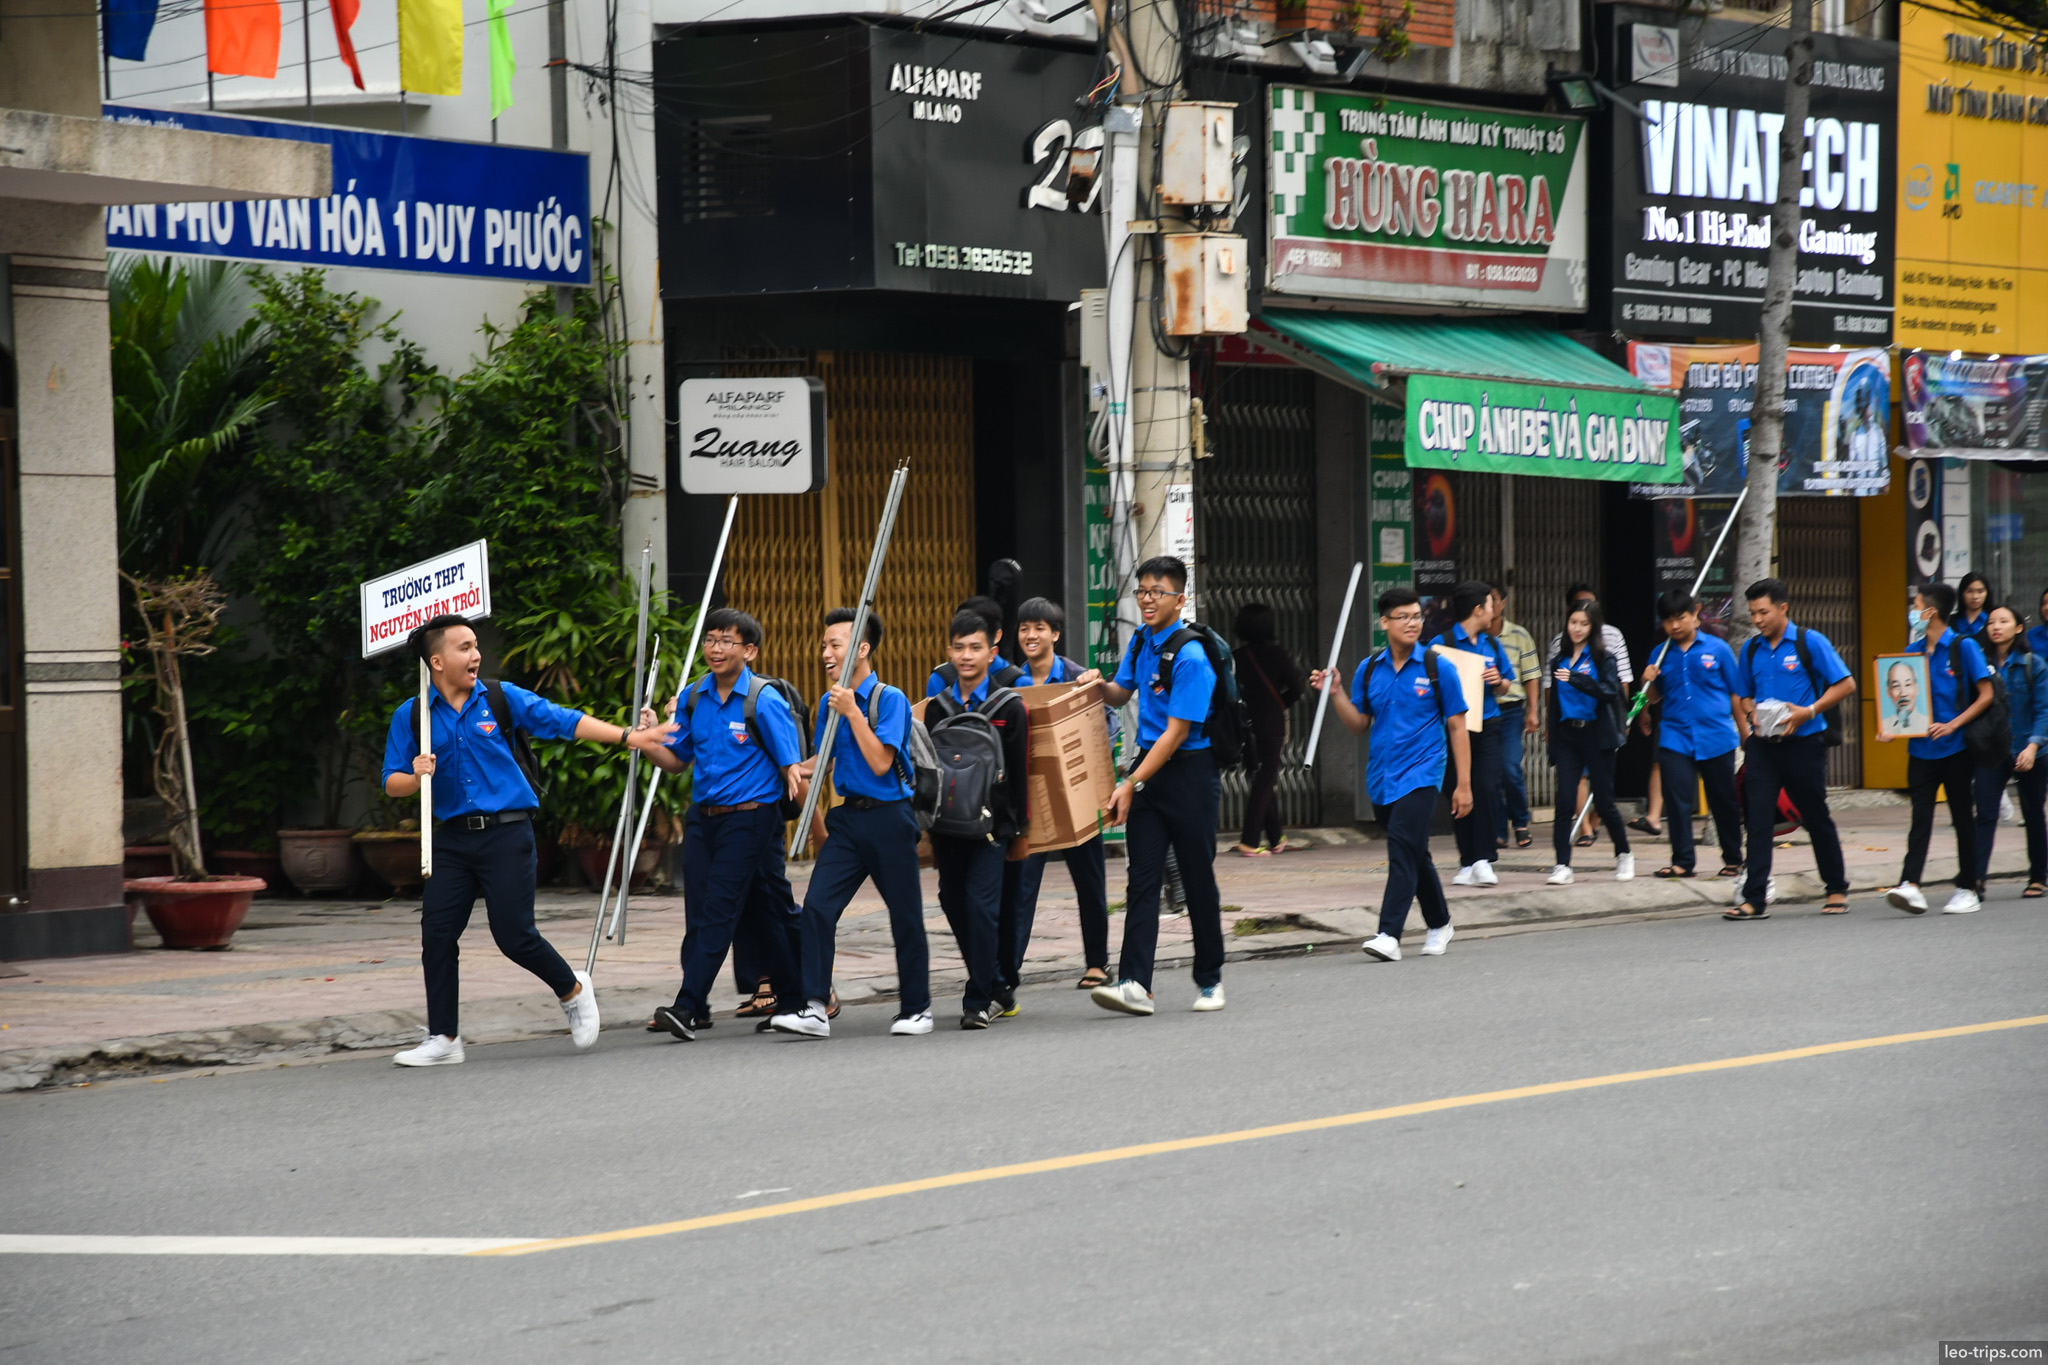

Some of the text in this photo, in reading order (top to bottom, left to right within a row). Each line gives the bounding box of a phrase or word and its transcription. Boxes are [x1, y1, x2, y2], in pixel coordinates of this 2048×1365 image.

[890, 62, 982, 100] ALFAPARF
[1339, 108, 1388, 135] TRUNG
[319, 179, 386, 256] HÓA
[392, 200, 408, 259] 1
[415, 201, 476, 264] DUY
[484, 196, 583, 274] PHƯỚC
[1442, 169, 1555, 246] HARA
[1643, 206, 1878, 265] No.1 Hi-End Gaming
[1625, 252, 1675, 287] Gaming
[1688, 362, 1720, 389] MUA
[1788, 364, 1835, 390] COMBO
[705, 391, 786, 404] ALFAPARF
[1418, 390, 1670, 466] CHỤP ẢNH BÉ VÀ GIA ĐÌNH
[720, 458, 784, 468] HAIR SALON
[1373, 470, 1411, 493] CHỤP
[382, 562, 465, 608] TRƯỜNG THPT
[370, 581, 480, 643] NGUYỄN VĂN TRỖI
